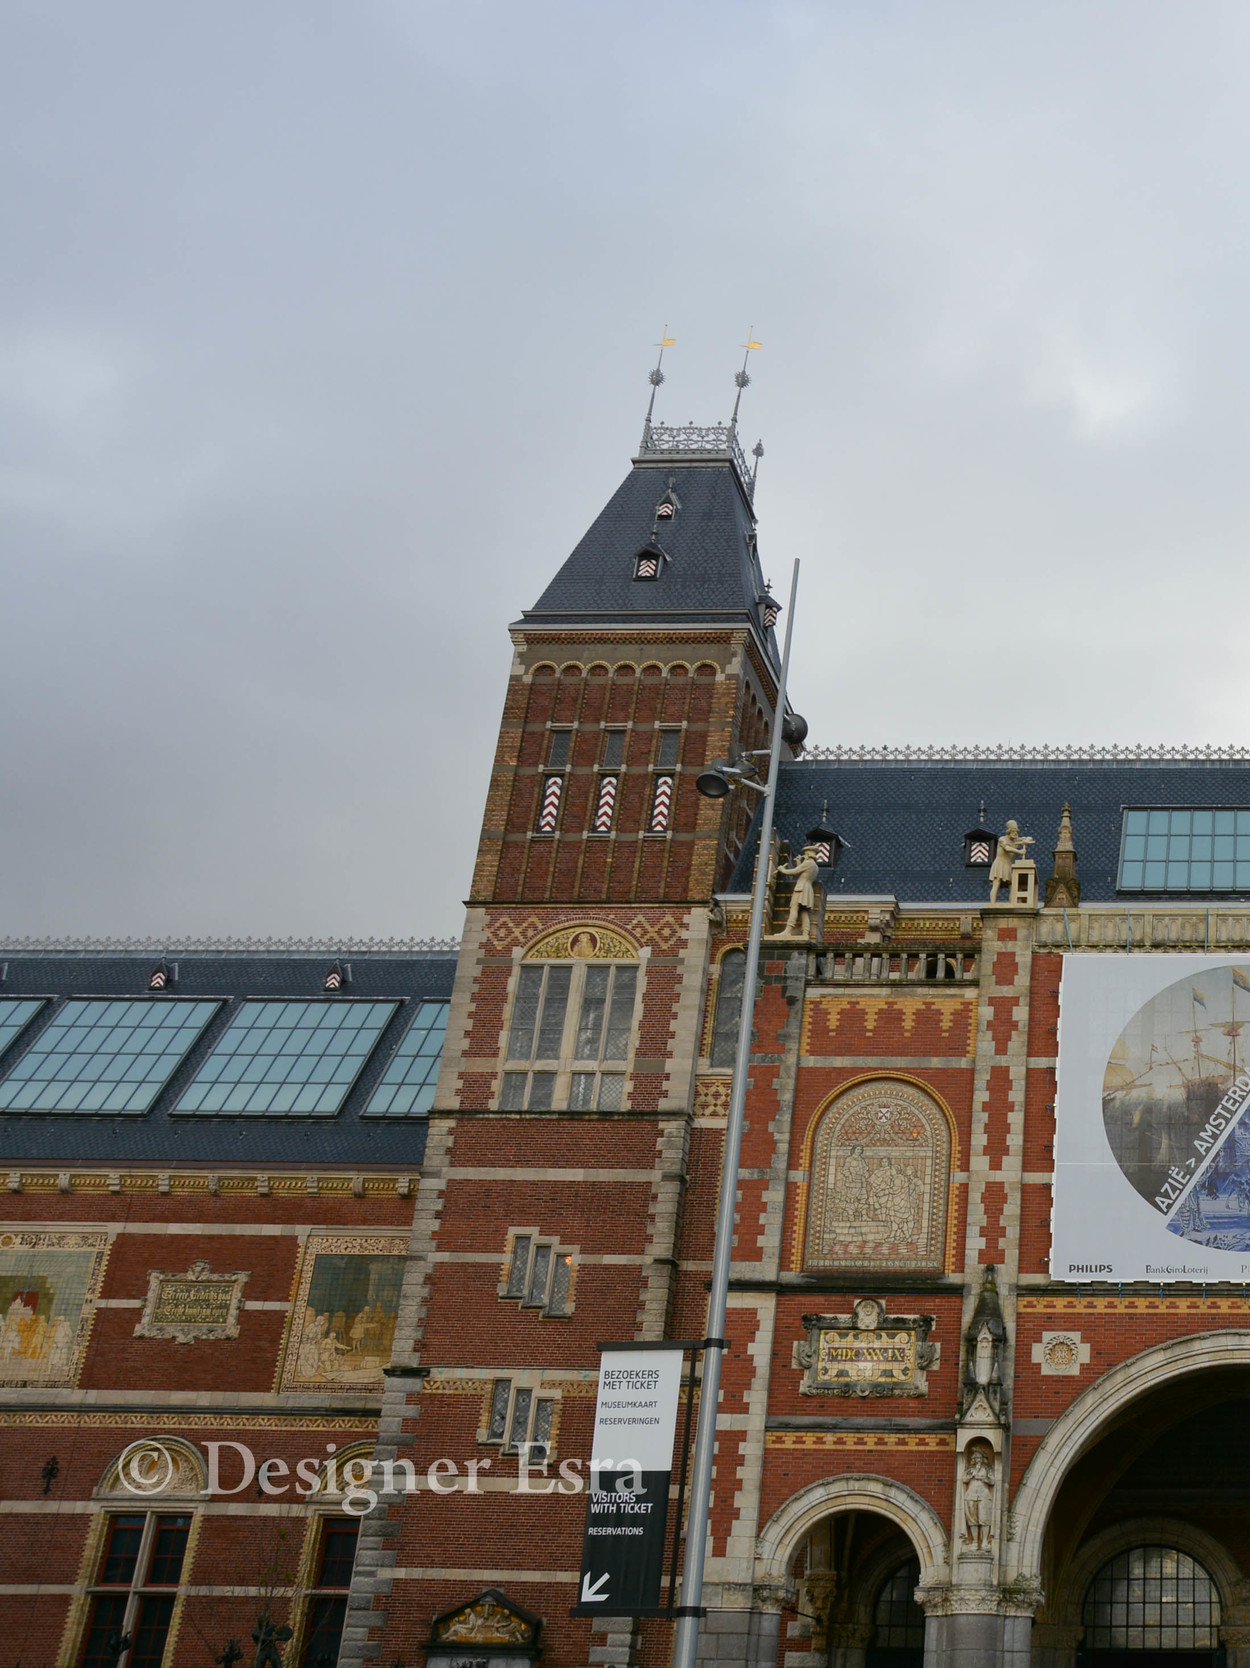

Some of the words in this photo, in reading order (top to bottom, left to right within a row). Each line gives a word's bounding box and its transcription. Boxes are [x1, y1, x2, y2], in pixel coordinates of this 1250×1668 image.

[1154, 1165, 1190, 1212] AZIË
[1068, 1264, 1113, 1273] PHILIPS
[1145, 1264, 1209, 1275] BankGiroLoterij
[604, 1369, 660, 1380] BEZOEKERS
[602, 1380, 624, 1390] MET
[625, 1380, 659, 1390] TICKET
[600, 1400, 658, 1409] MUSEUMKAART
[599, 1417, 660, 1426] RESERVERINGEN
[592, 1492, 636, 1503] VISITORS
[590, 1503, 617, 1514] WITH
[619, 1503, 653, 1514] TICKET
[588, 1527, 644, 1536] RESERVATIONS
